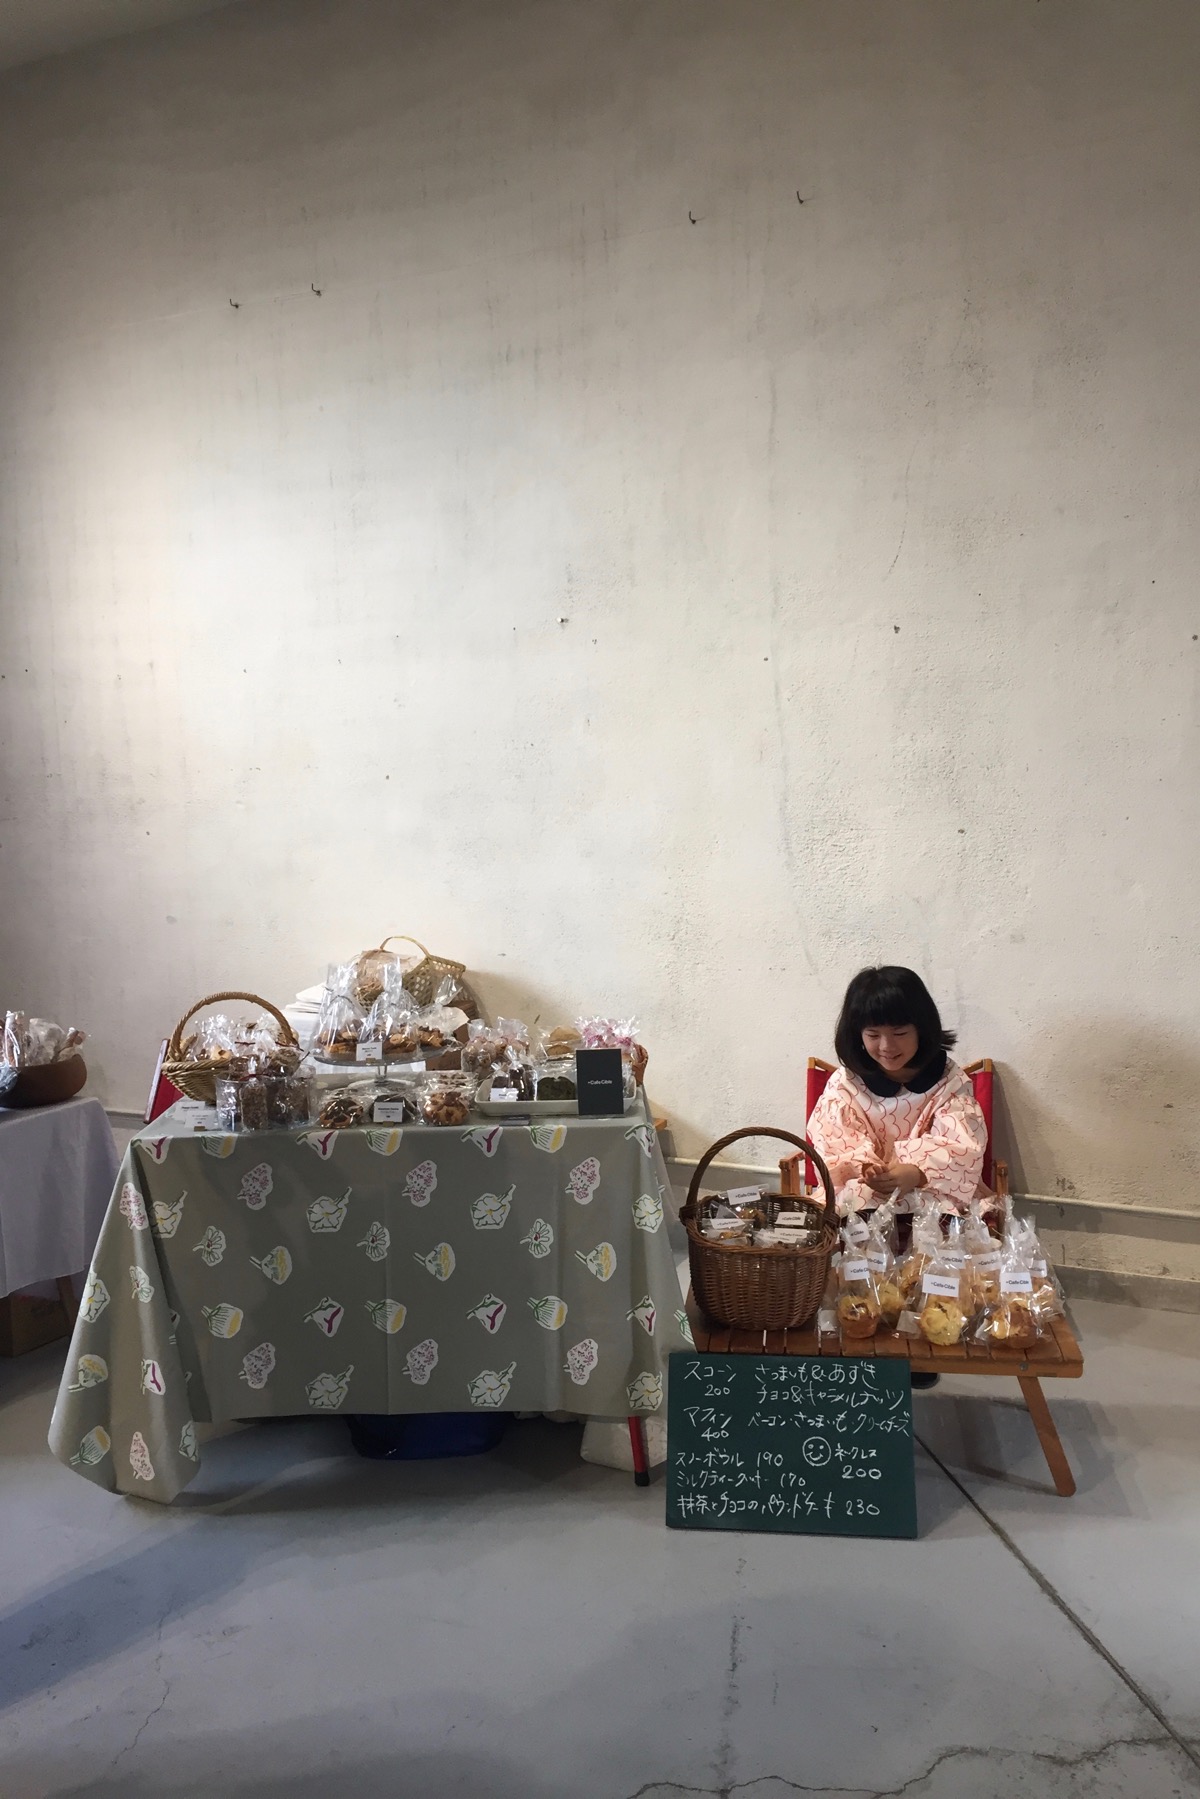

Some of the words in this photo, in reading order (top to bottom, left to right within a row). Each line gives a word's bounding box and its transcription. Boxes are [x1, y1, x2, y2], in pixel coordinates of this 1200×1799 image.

[684, 1361, 737, 1383] スコーン
[704, 1384, 731, 1396] 200
[683, 1406, 732, 1429] マフィン
[701, 1427, 729, 1442] 400
[757, 1451, 784, 1467] 190
[780, 1472, 806, 1488] 170
[841, 1464, 882, 1480] 200
[845, 1498, 881, 1516] 230
